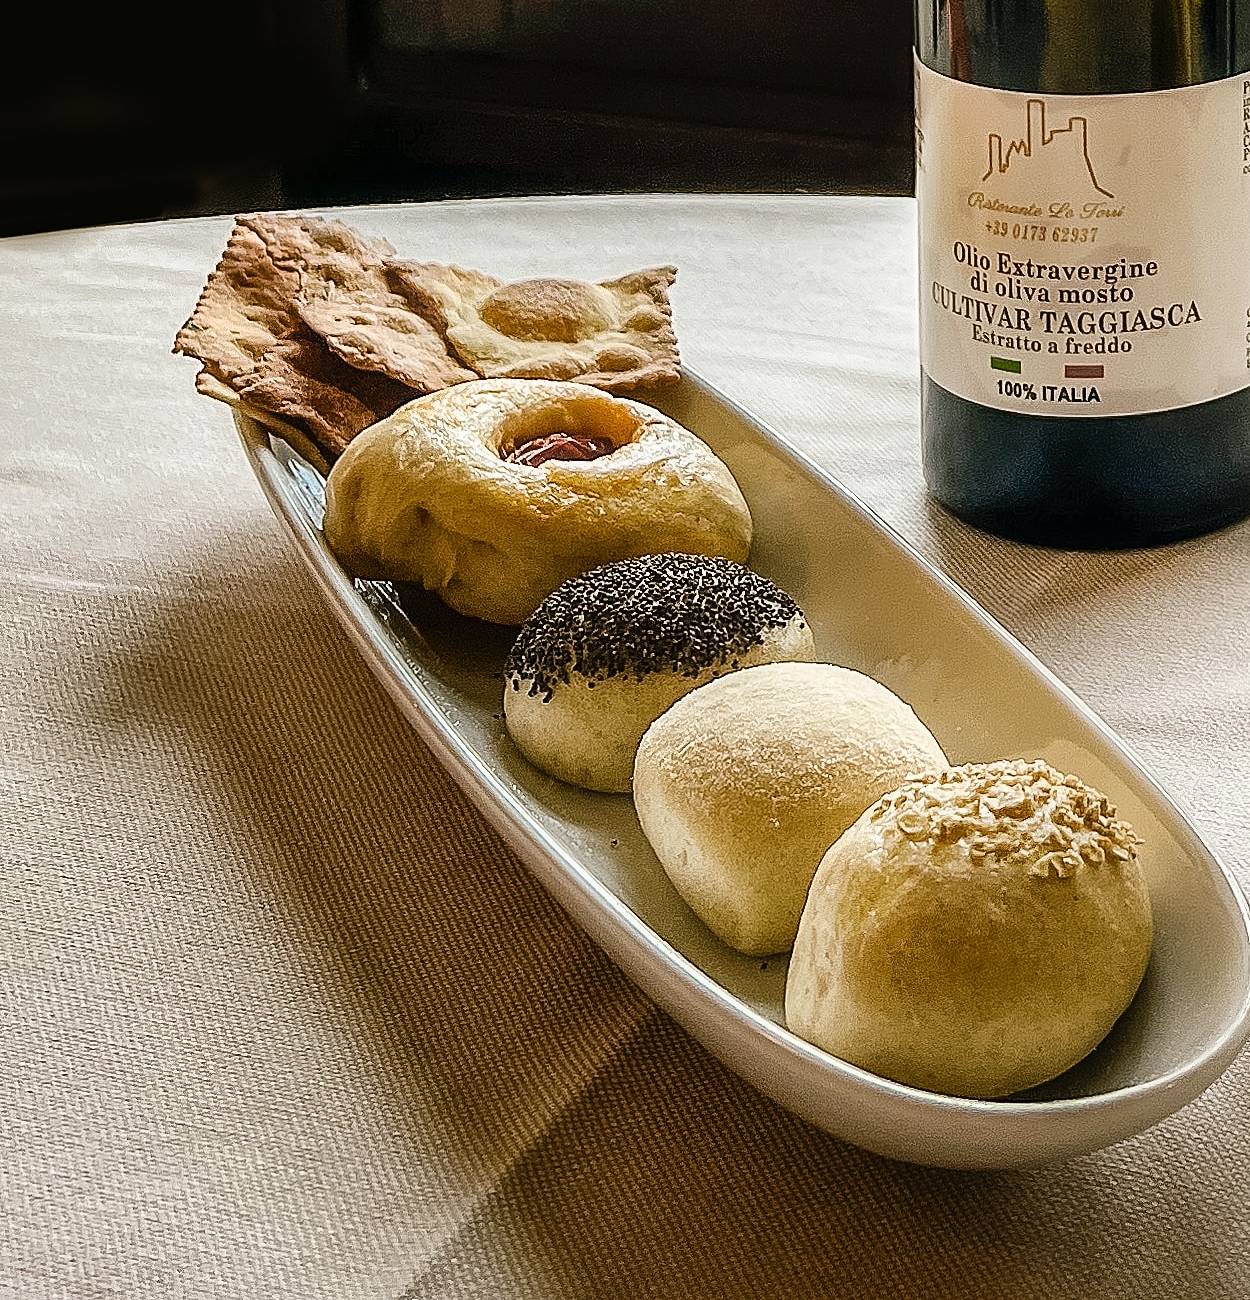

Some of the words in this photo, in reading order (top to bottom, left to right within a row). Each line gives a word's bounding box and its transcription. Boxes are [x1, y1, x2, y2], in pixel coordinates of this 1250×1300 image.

[967, 191, 1043, 217] Ristorante
[985, 220, 1009, 237] +39
[1012, 224, 1047, 241] 0173
[1052, 227, 1099, 243] 62937
[953, 241, 991, 271] Olio
[997, 252, 1158, 284] Extravergine
[970, 271, 989, 294] di
[995, 279, 1050, 304] oliva
[1058, 284, 1134, 304] mosto
[931, 281, 1032, 331] CULTIVAR
[1040, 300, 1202, 335] TAGGIASCA
[972, 324, 1042, 352] Estratto
[1047, 341, 1059, 354] a
[1064, 337, 1133, 355] freddo
[997, 379, 1037, 401] 100%
[1042, 385, 1101, 403] ITALIA
